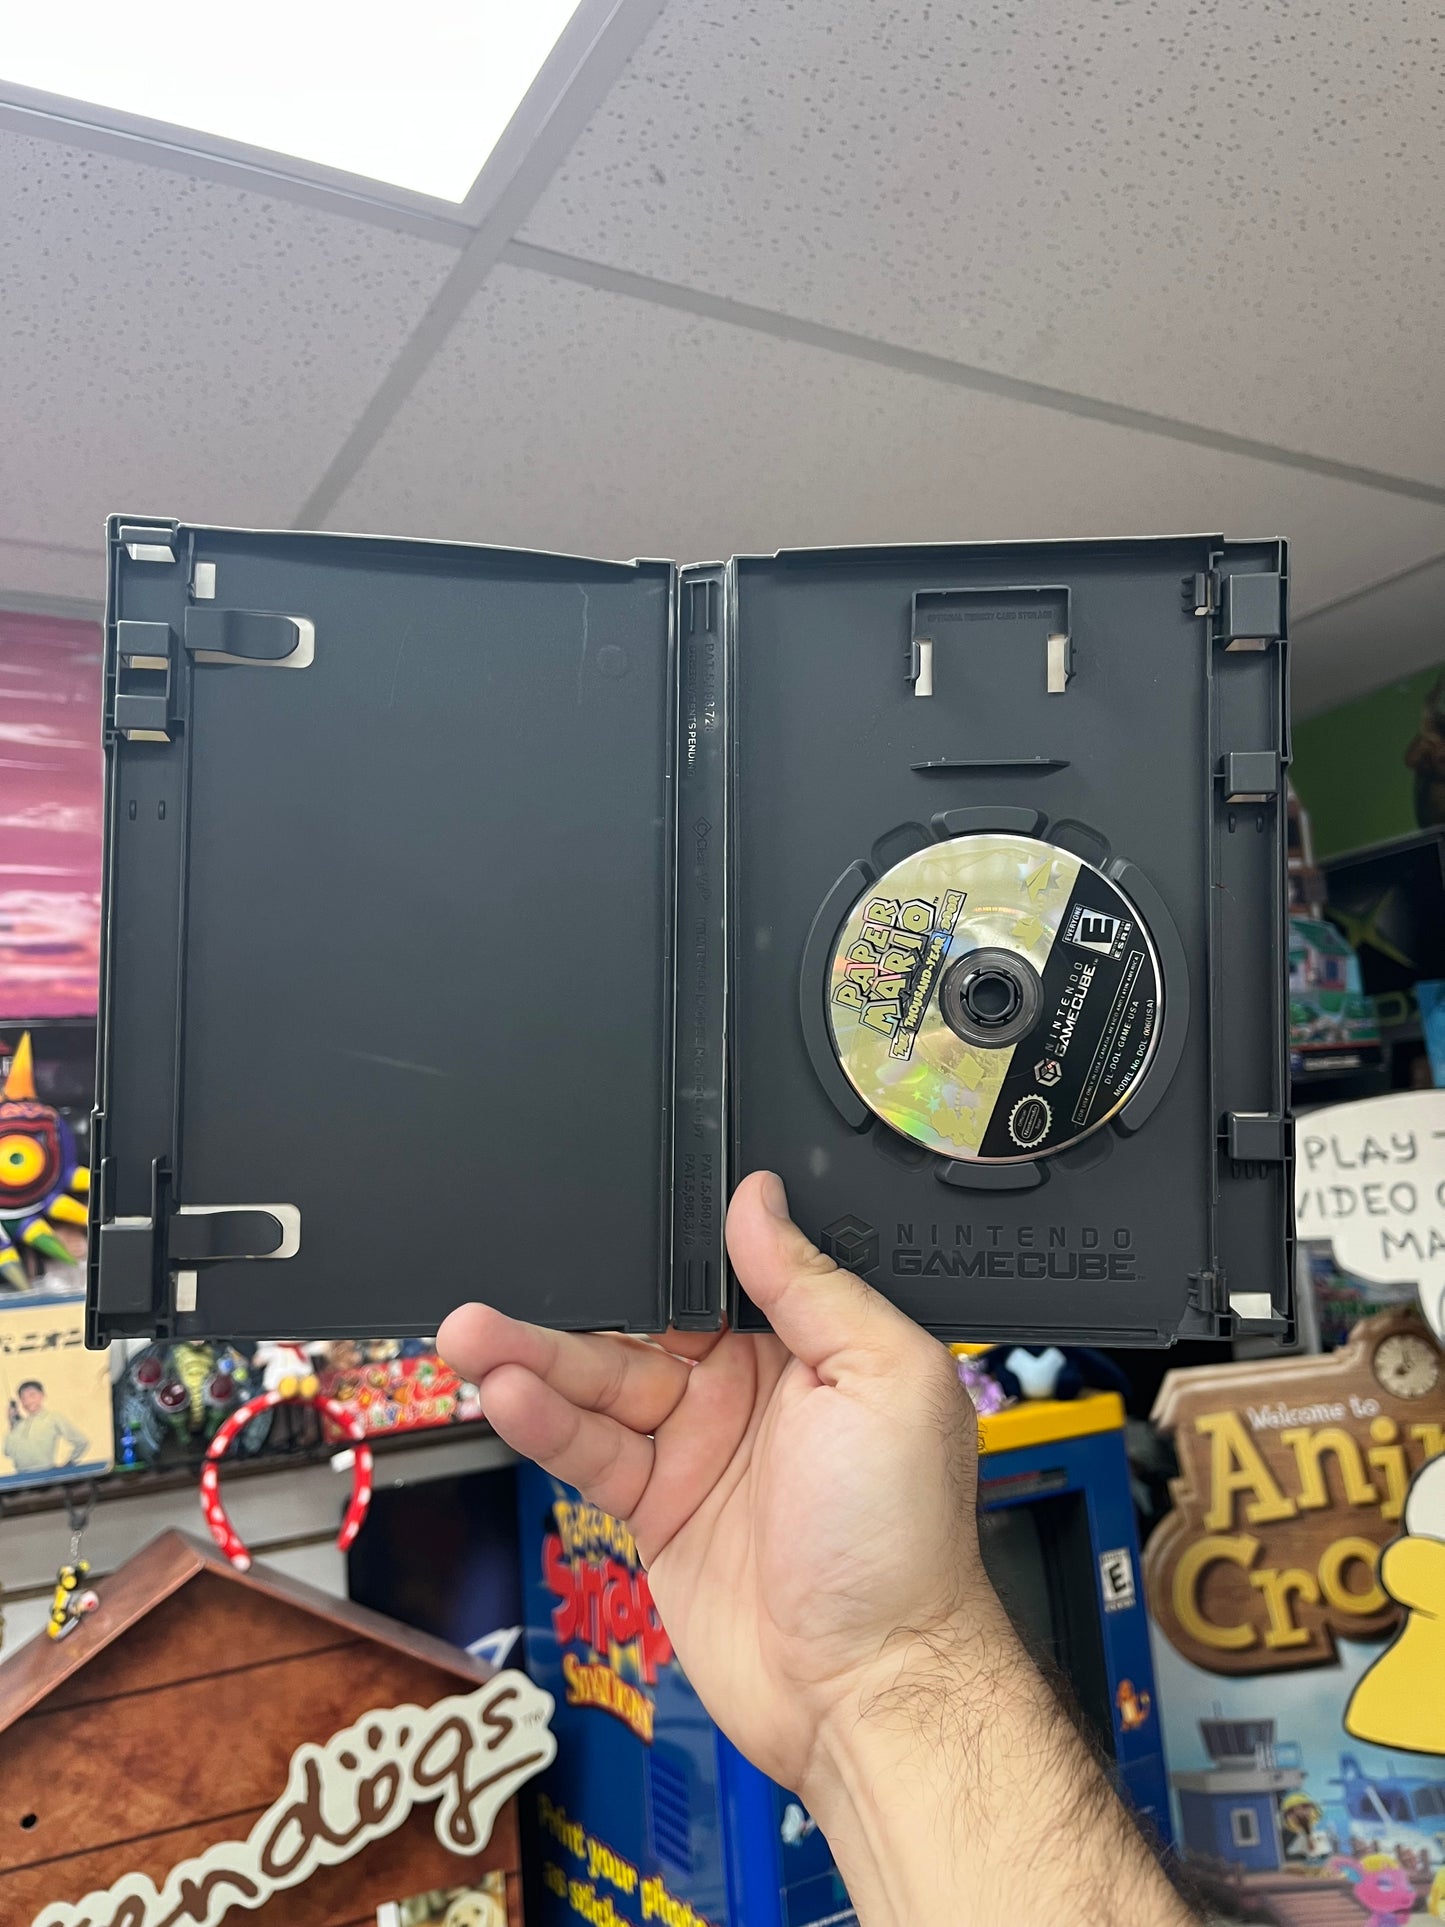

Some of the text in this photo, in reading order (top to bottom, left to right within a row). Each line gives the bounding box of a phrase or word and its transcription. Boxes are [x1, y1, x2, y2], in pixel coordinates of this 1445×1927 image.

[1065, 906, 1083, 942] EVERYONE
[1082, 918, 1114, 943] E
[1115, 923, 1132, 958] ESRB
[832, 897, 900, 1012] PAPER
[859, 901, 936, 1039] MARIO
[904, 935, 945, 1027] THOUSAND-YEAR
[941, 895, 960, 931] DOOR
[1045, 961, 1084, 1052] NINTENDO
[1055, 964, 1097, 1058] GAMECUBE
[1114, 1072, 1135, 1097] MODEL
[1024, 1106, 1038, 1136] Nintendo
[1303, 1131, 1418, 1171] PLAY
[896, 1224, 1132, 1250] NINTENDO
[892, 1249, 1138, 1281] GAMECUBE
[1247, 1395, 1381, 1430] Welcome to
